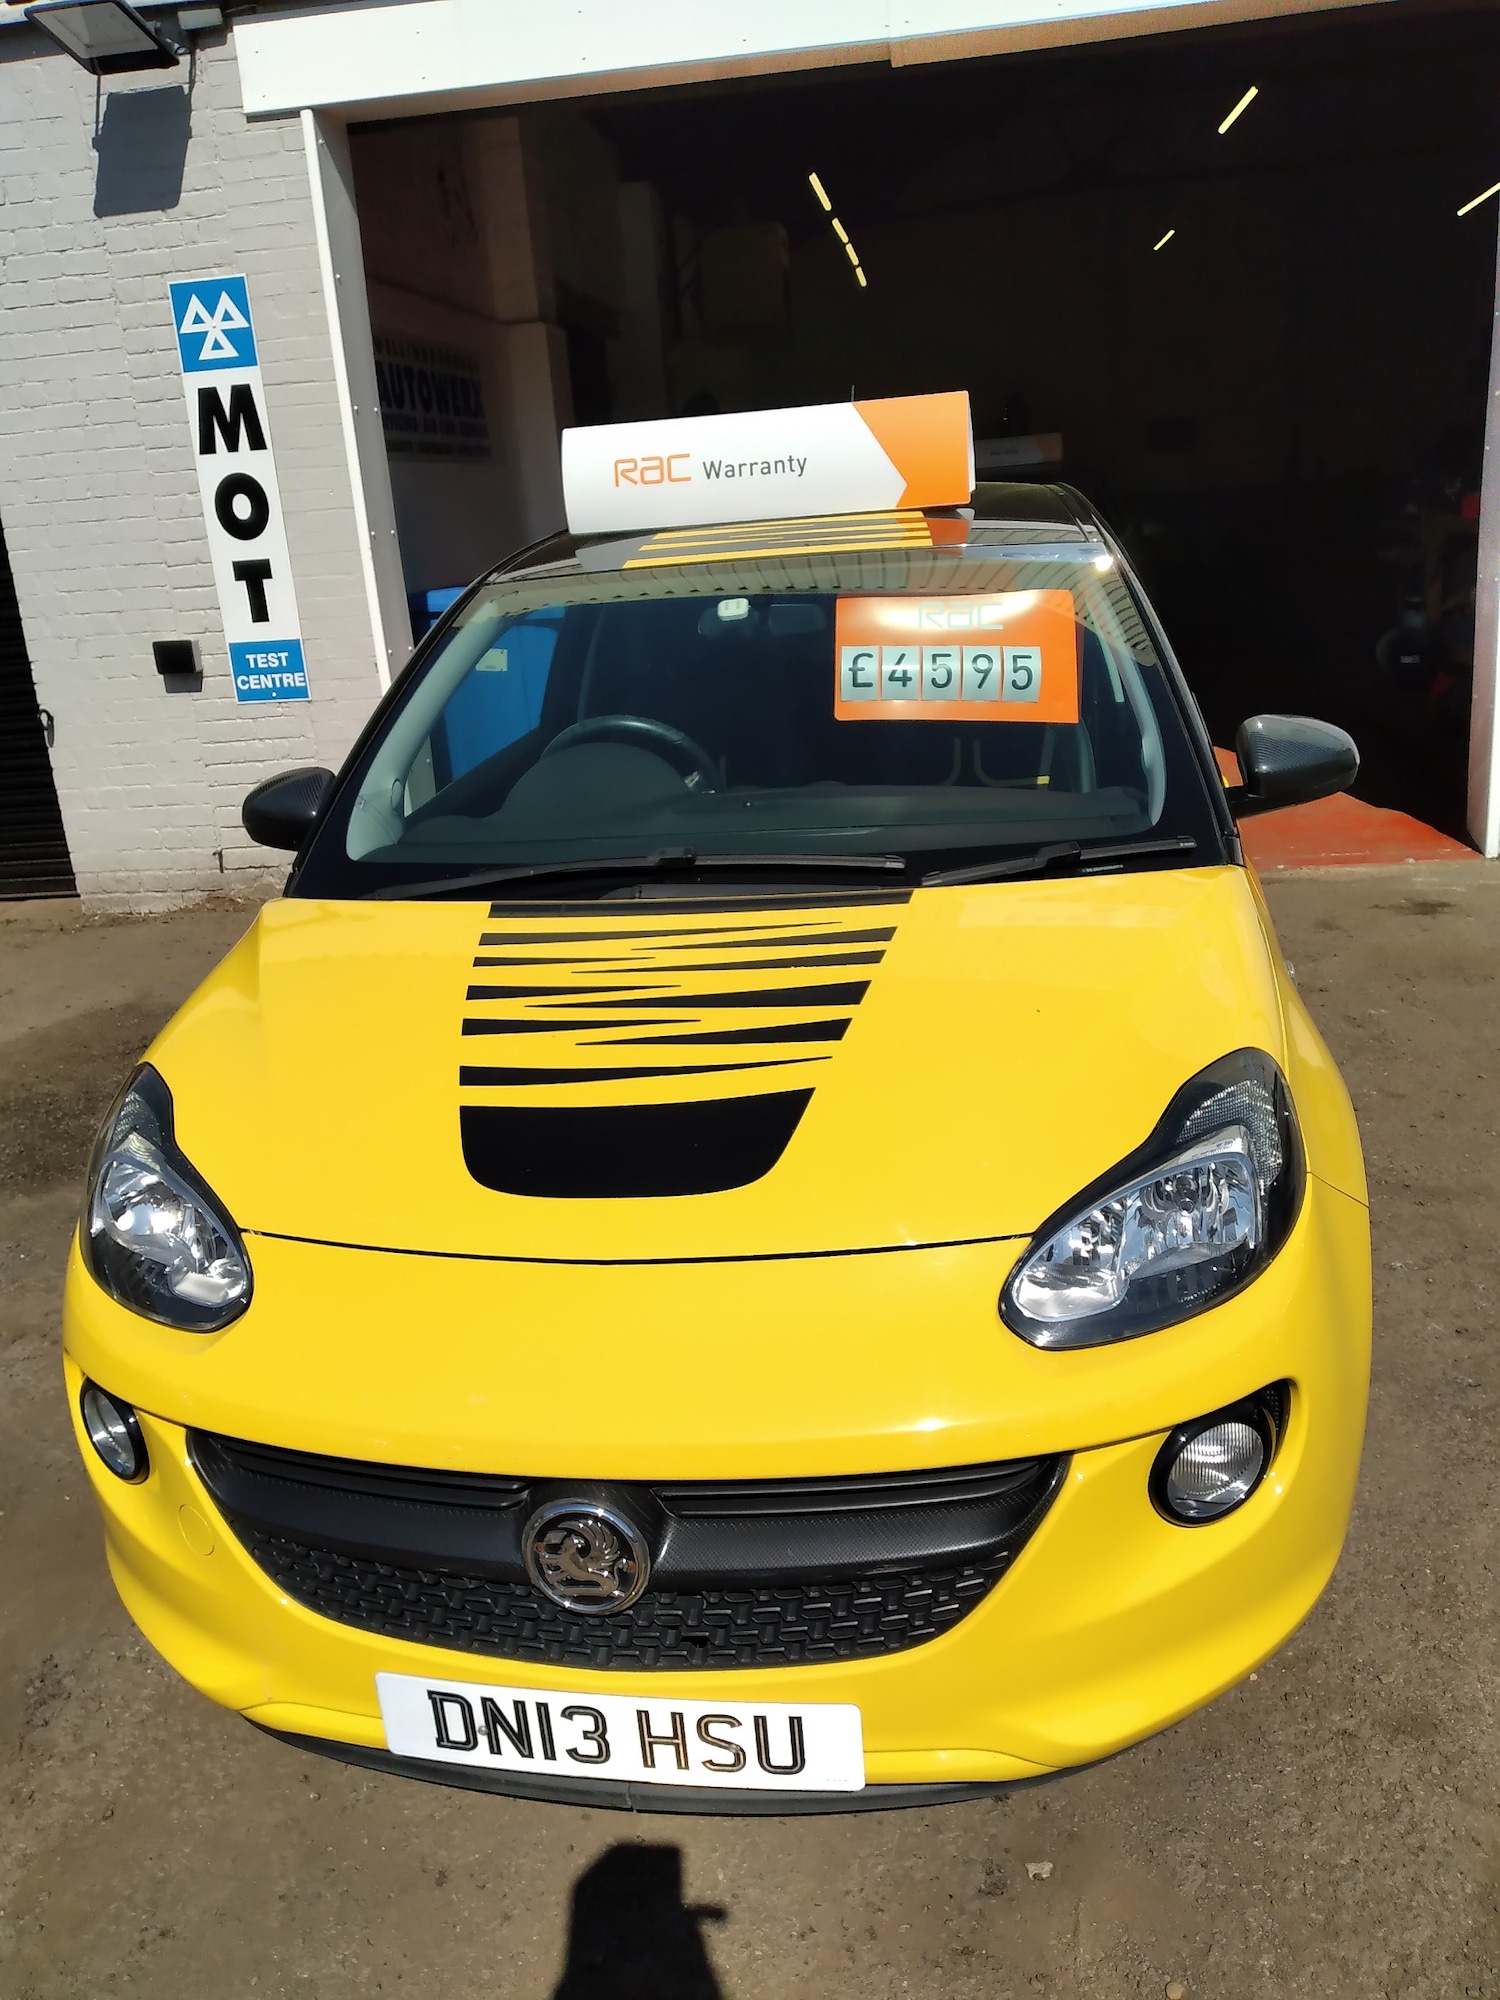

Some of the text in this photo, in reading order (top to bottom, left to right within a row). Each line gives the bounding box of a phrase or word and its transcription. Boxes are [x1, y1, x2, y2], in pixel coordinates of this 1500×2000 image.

[702, 454, 808, 480] Warranty
[198, 384, 272, 622] MOT
[245, 652, 289, 669] TEST
[848, 652, 1034, 691] £4595
[237, 671, 306, 691] CENTRE
[427, 1689, 807, 1775] DN13 HSU
